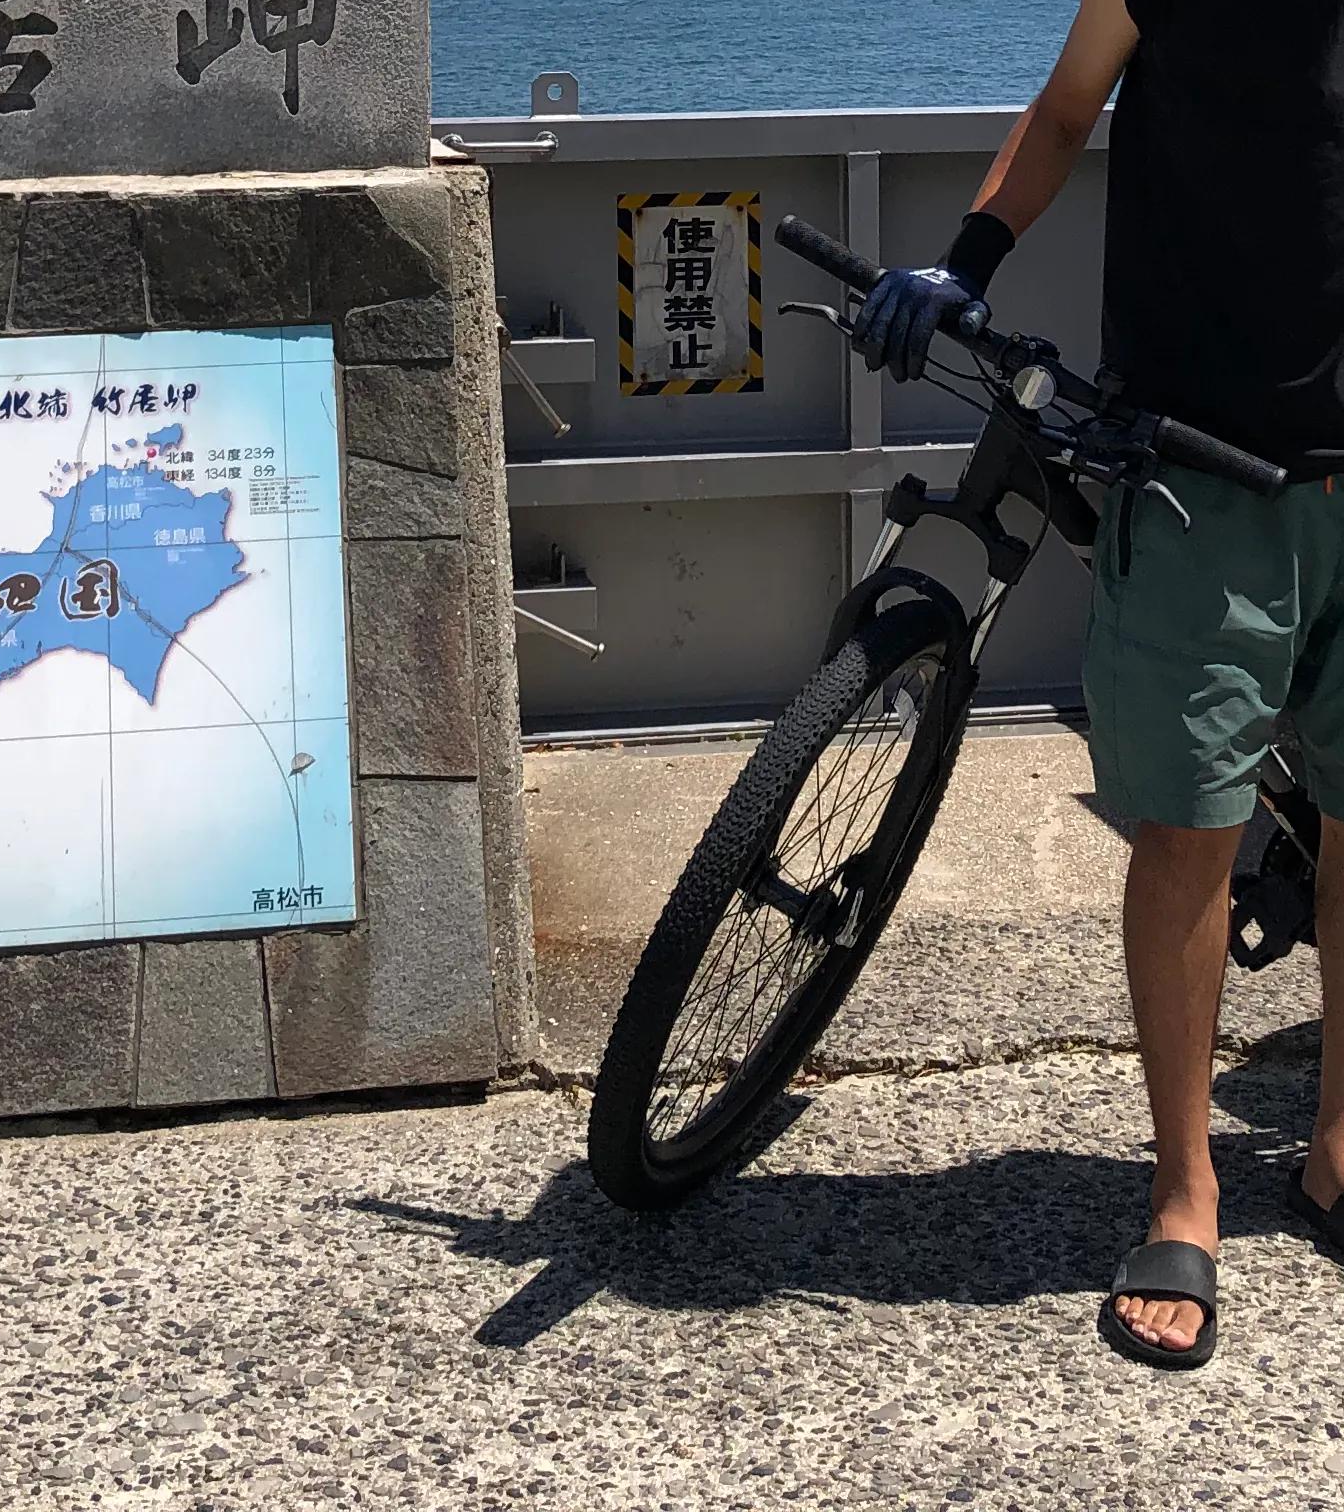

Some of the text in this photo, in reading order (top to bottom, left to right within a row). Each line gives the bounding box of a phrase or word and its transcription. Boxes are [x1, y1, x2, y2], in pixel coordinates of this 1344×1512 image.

[662, 217, 716, 370] 使用禁止
[91, 383, 197, 417] 竹居岬
[166, 452, 194, 464] 北緯
[166, 469, 195, 482] 東経
[90, 503, 141, 522] 香川県
[154, 528, 205, 545] 徳島県
[252, 885, 324, 912] 高松市
